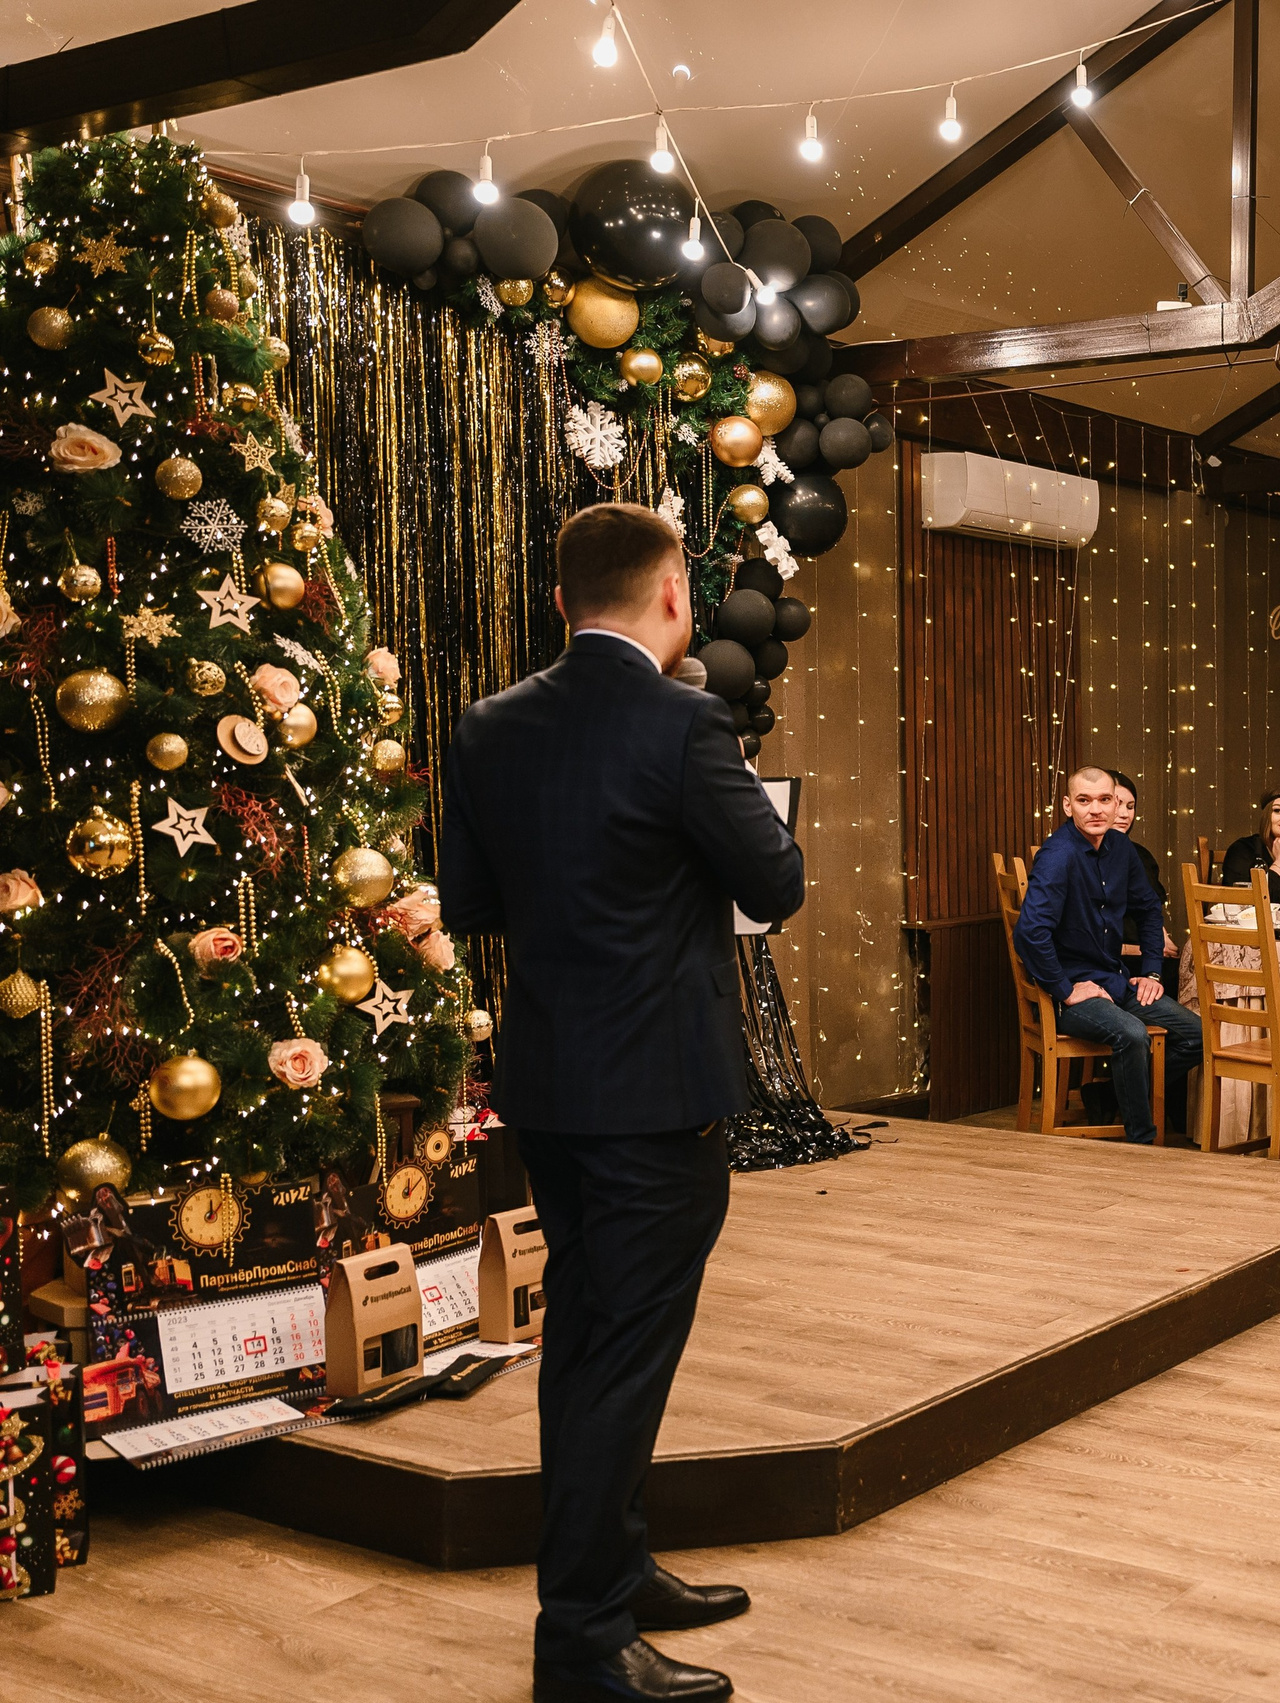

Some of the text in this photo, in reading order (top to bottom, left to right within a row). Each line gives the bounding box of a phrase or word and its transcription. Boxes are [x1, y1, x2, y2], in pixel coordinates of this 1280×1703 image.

[410, 1221, 479, 1253] ртнёрПромСнаб
[201, 1256, 317, 1288] ПартнёрПромСнаб
[167, 1316, 188, 1326] 2023
[290, 1313, 295, 1321] 2
[192, 1341, 198, 1349] 4
[212, 1338, 218, 1346] 5
[232, 1334, 238, 1342] 6
[271, 1327, 278, 1335] 8
[291, 1323, 297, 1331] 9
[308, 1319, 319, 1327] 10
[192, 1352, 202, 1360] 11
[212, 1348, 222, 1356] 12
[251, 1341, 262, 1349] 14
[271, 1337, 282, 1345] 15
[290, 1333, 301, 1341] 16
[310, 1329, 320, 1337] 17
[192, 1362, 203, 1370] 18
[213, 1359, 224, 1367] 19
[233, 1355, 244, 1363] 20
[273, 1347, 283, 1355] 22
[292, 1343, 303, 1351] 23
[312, 1339, 322, 1347] 24
[194, 1373, 206, 1381] 25
[215, 1368, 226, 1377] 26
[235, 1365, 245, 1373] 27
[254, 1360, 265, 1369] 28
[274, 1356, 285, 1365] 29
[294, 1352, 305, 1361] 30
[314, 1348, 324, 1356] 31
[217, 1385, 254, 1399] ЗАПЧАСТИ
